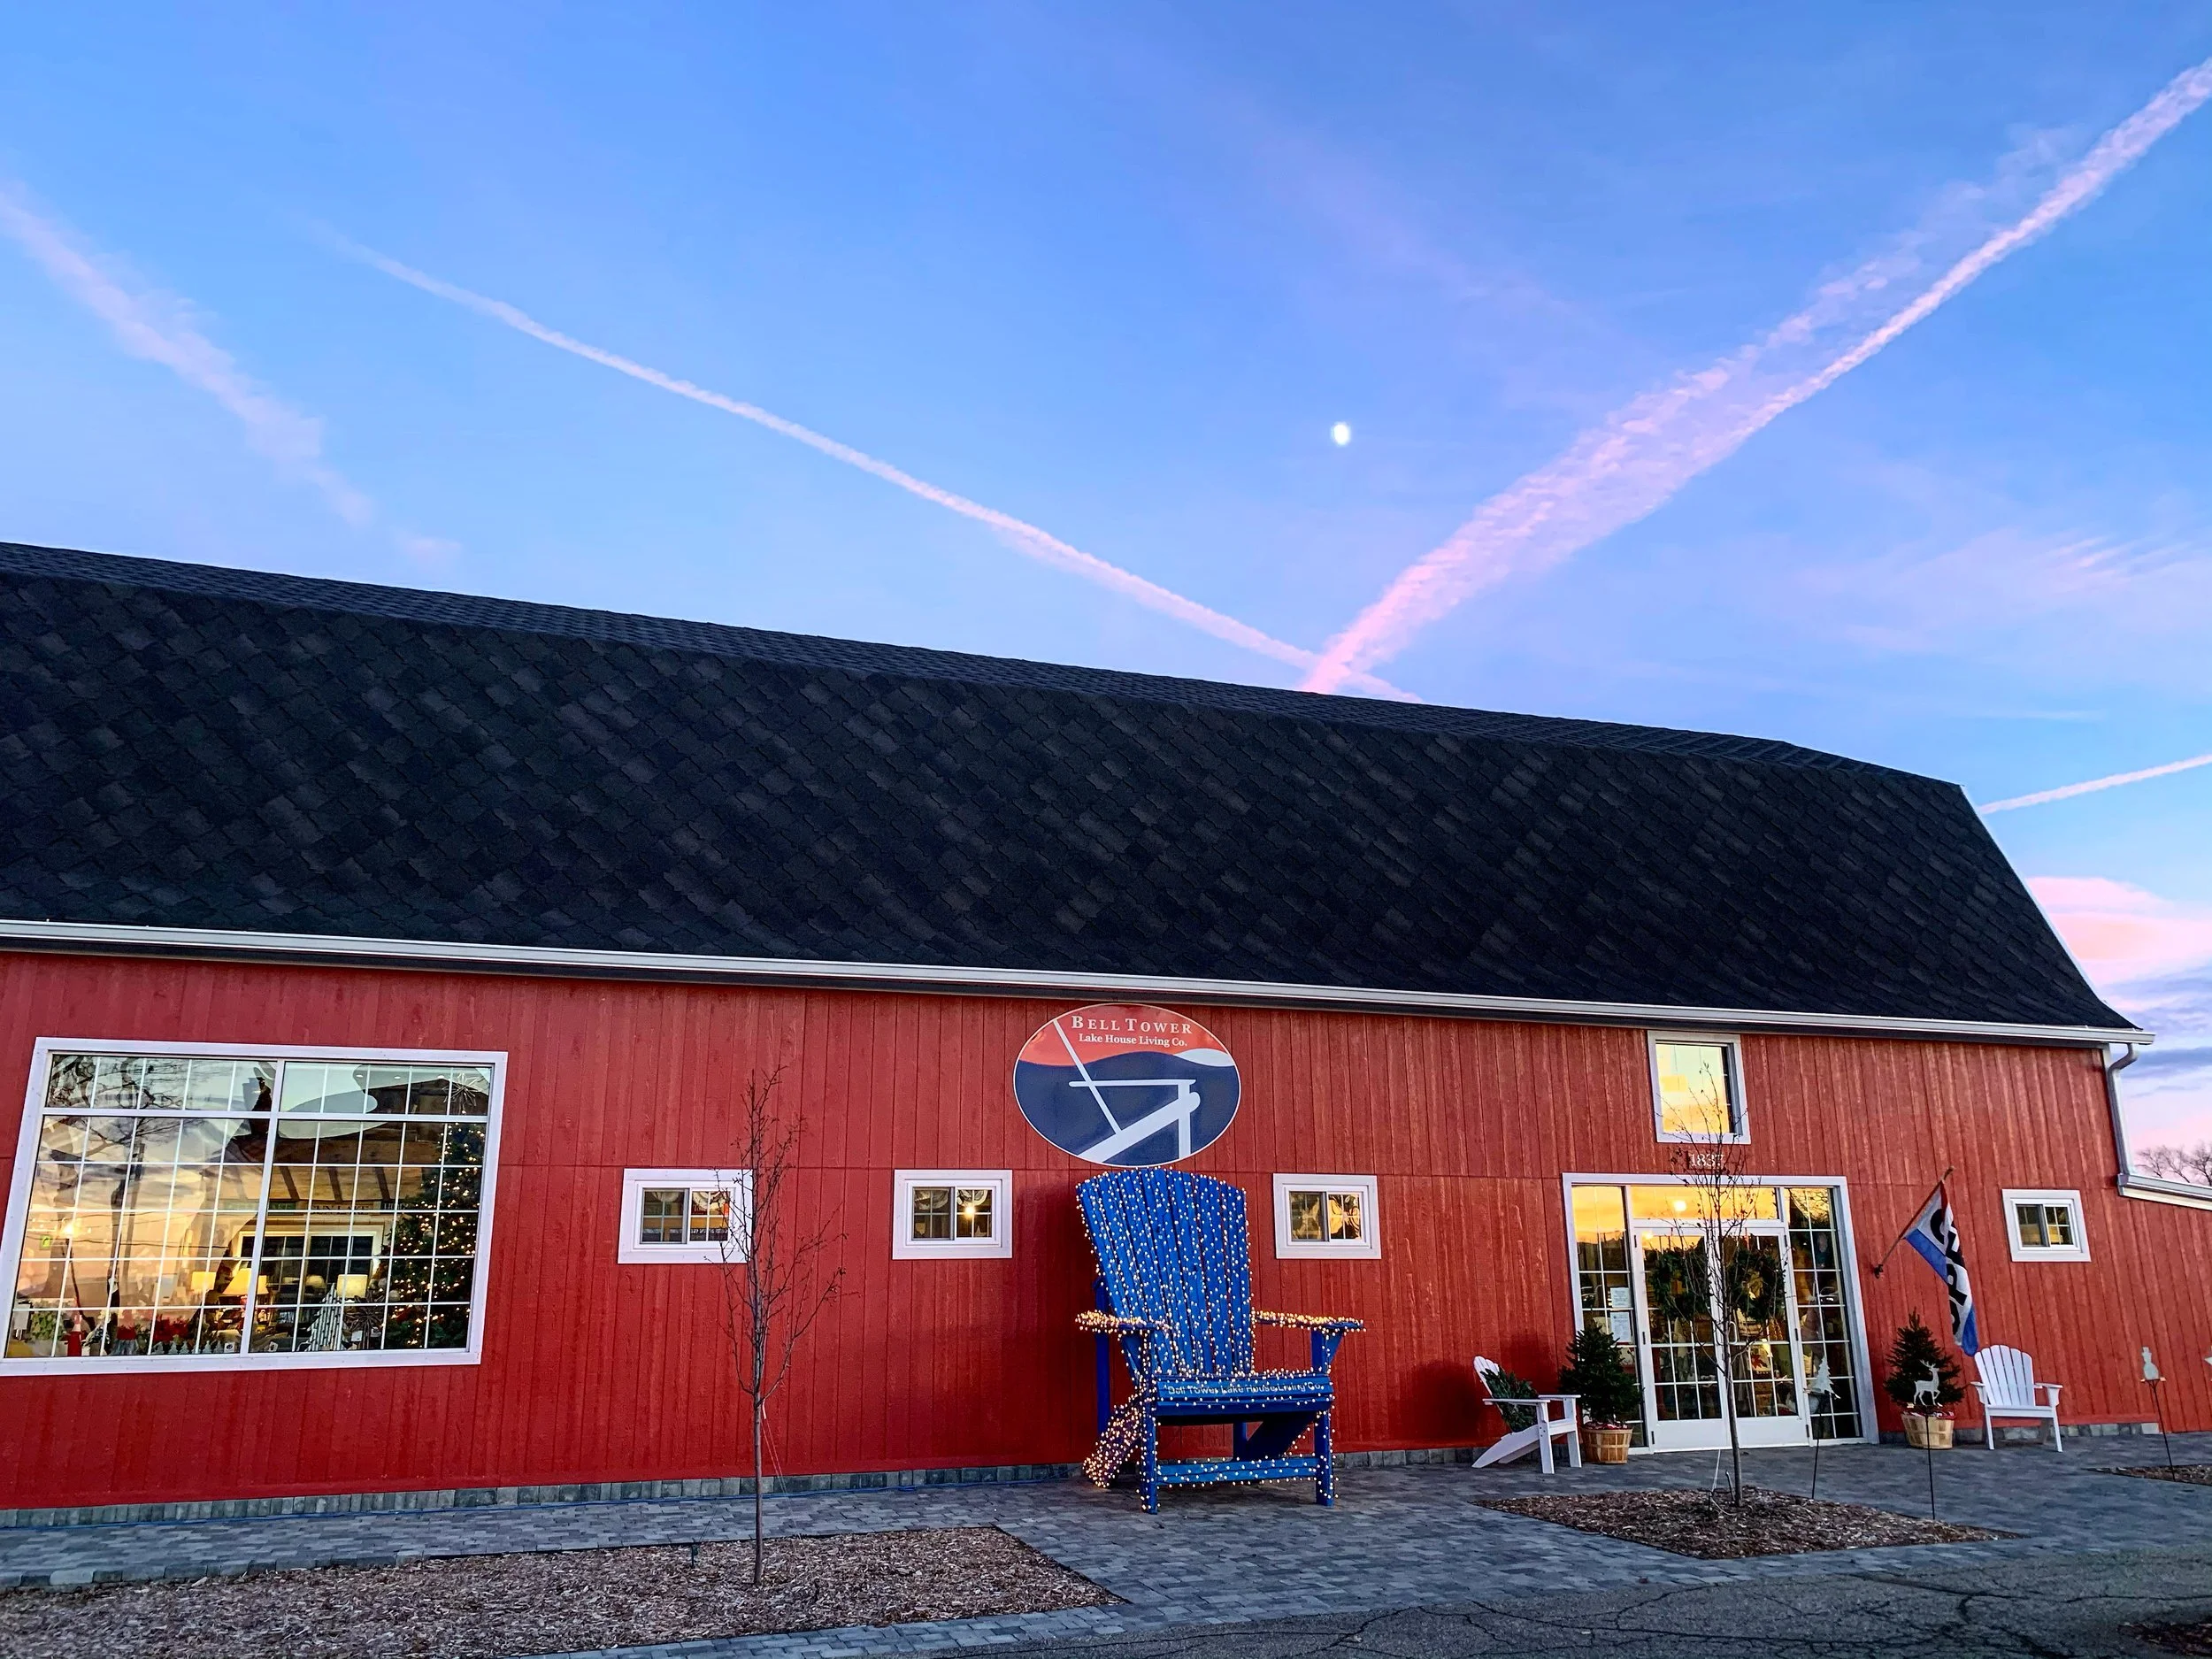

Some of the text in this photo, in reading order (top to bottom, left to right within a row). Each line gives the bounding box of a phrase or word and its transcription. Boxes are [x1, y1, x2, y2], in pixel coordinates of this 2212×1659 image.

[1071, 1015, 1192, 1034] BELL TOWER
[1079, 1033, 1102, 1042] Lake
[1104, 1034, 1137, 1044] House
[1139, 1036, 1171, 1048] Living
